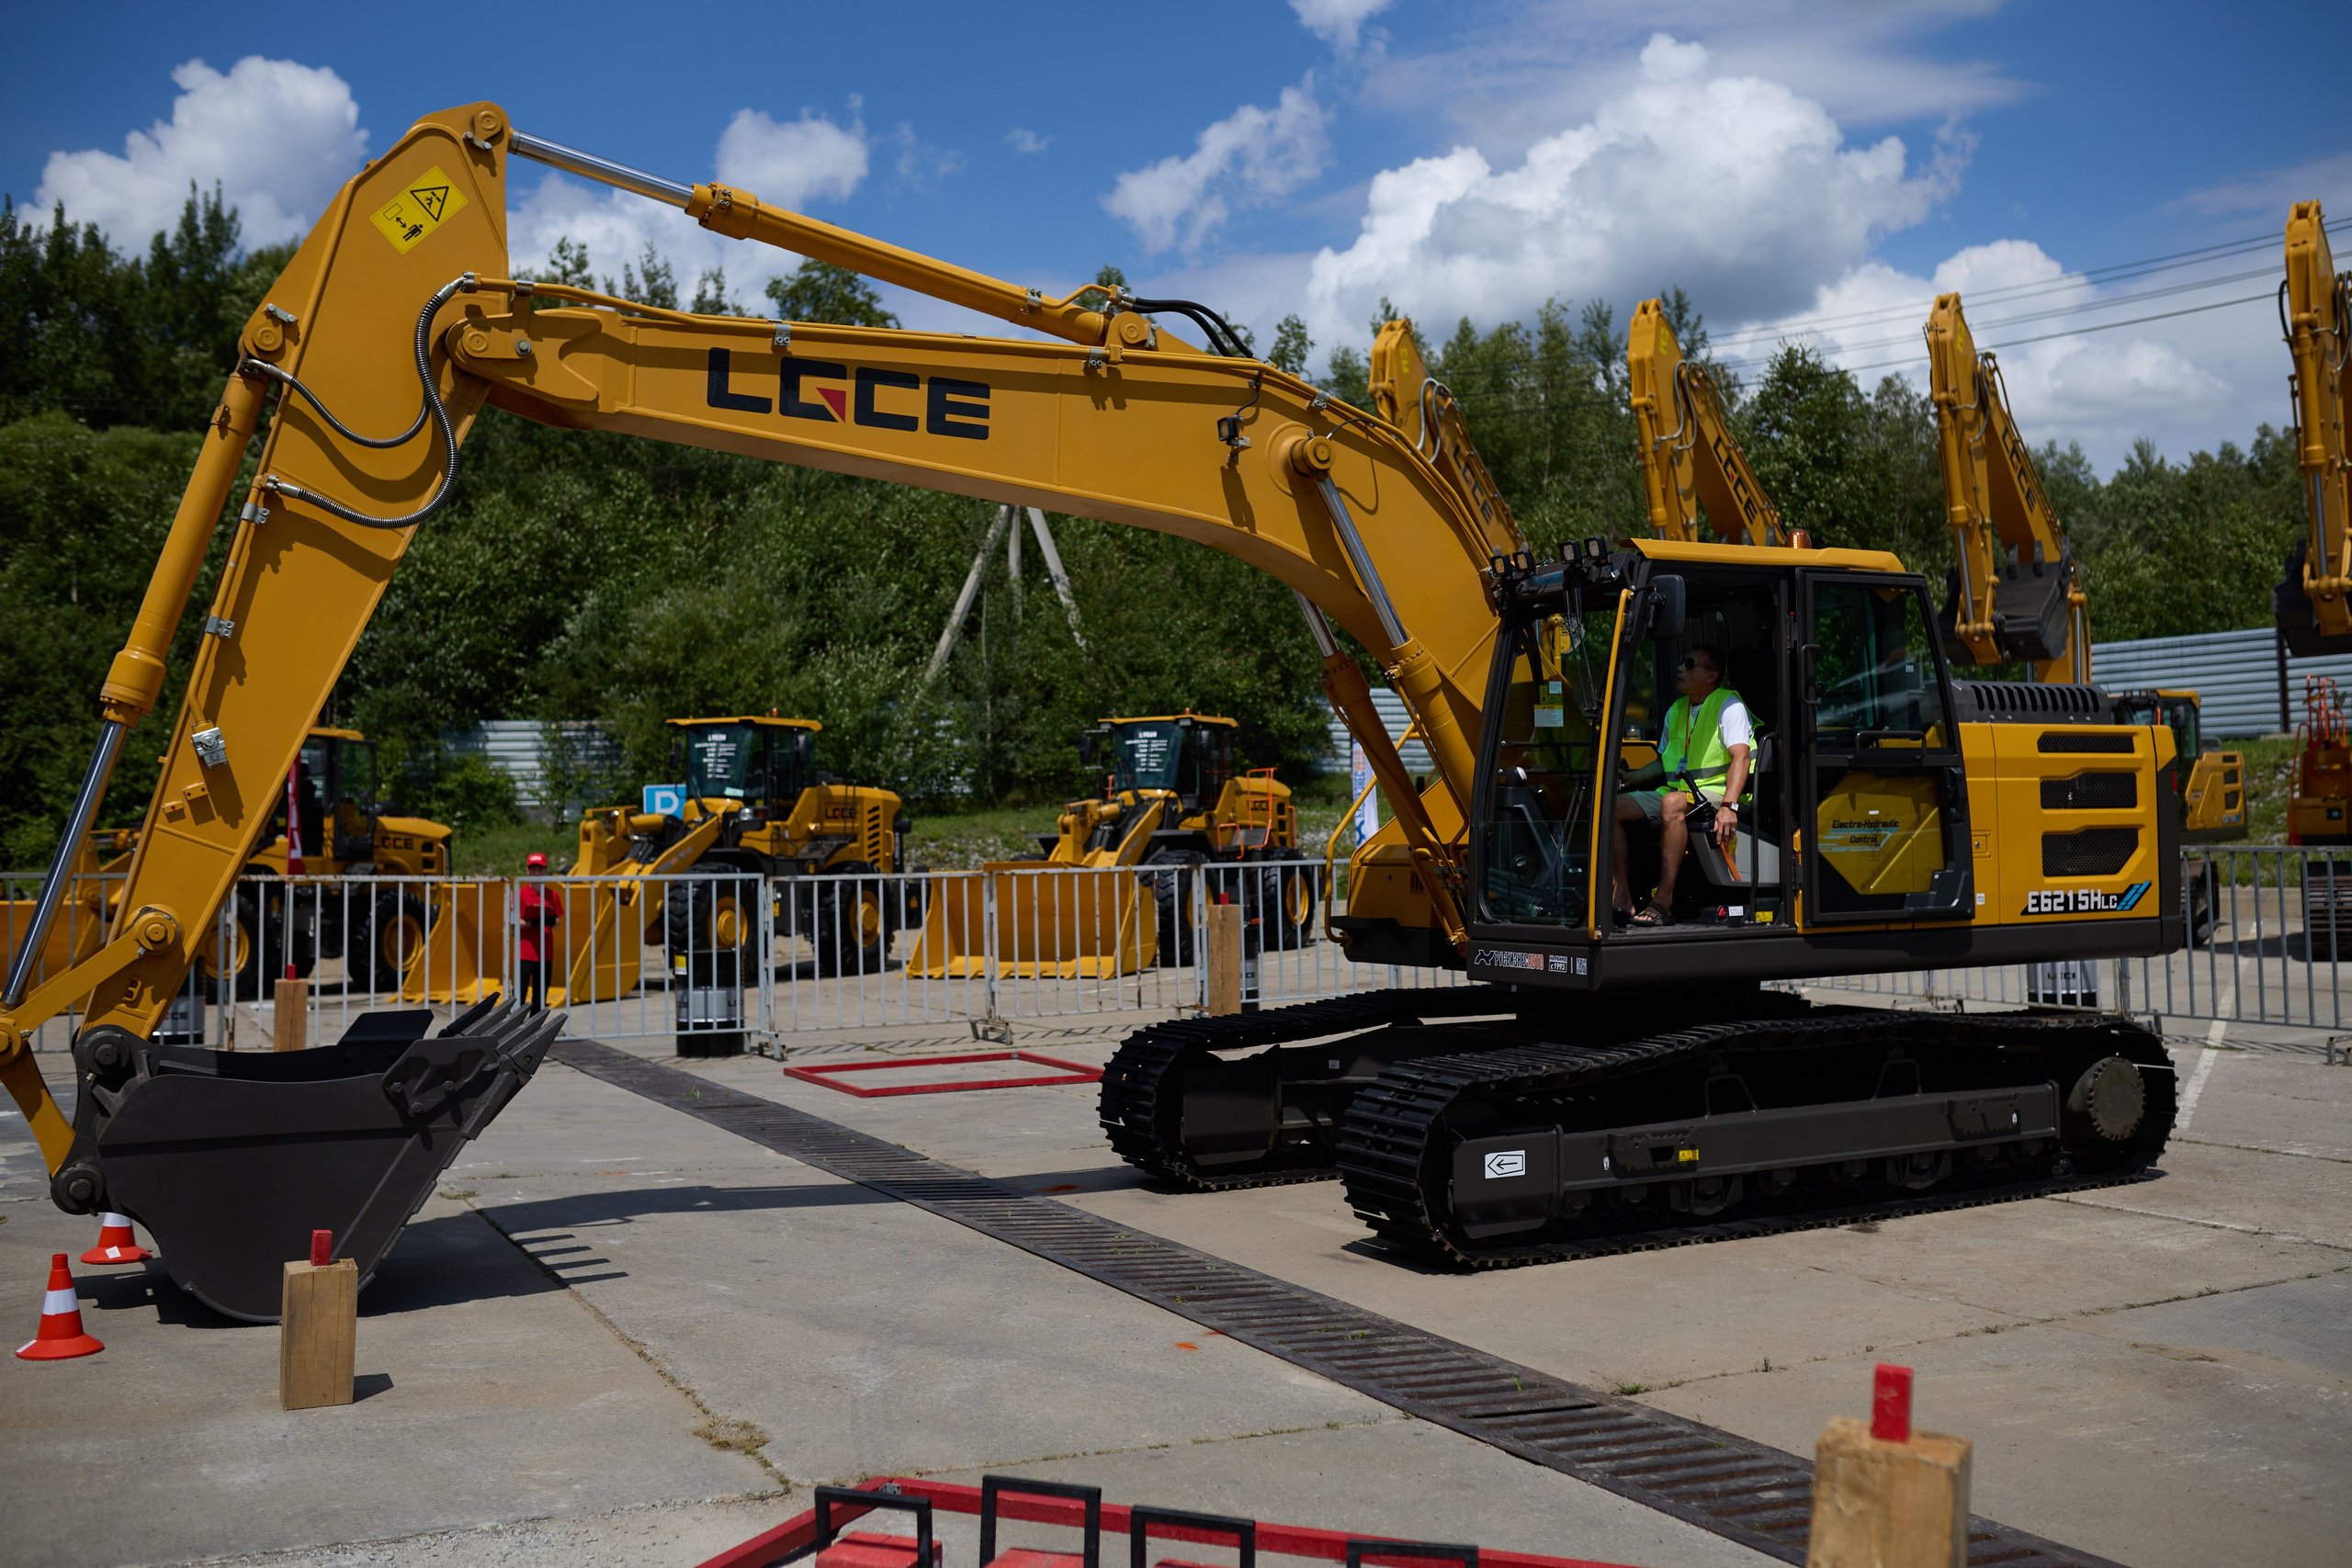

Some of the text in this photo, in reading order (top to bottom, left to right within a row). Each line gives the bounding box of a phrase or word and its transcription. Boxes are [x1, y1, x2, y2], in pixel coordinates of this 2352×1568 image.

[707, 347, 990, 440] LGCE
[1713, 435, 1758, 525] LGCE
[2002, 426, 2036, 513] LGCE
[1453, 444, 1493, 525] LGCE
[825, 807, 856, 819] LGCE
[1832, 819, 1899, 829] Electro-Hydraulic
[1850, 835, 1878, 843] Control
[2028, 888, 2118, 912] E6215HLC
[1495, 951, 1544, 970] РУСБИЗНЕСАВТО
